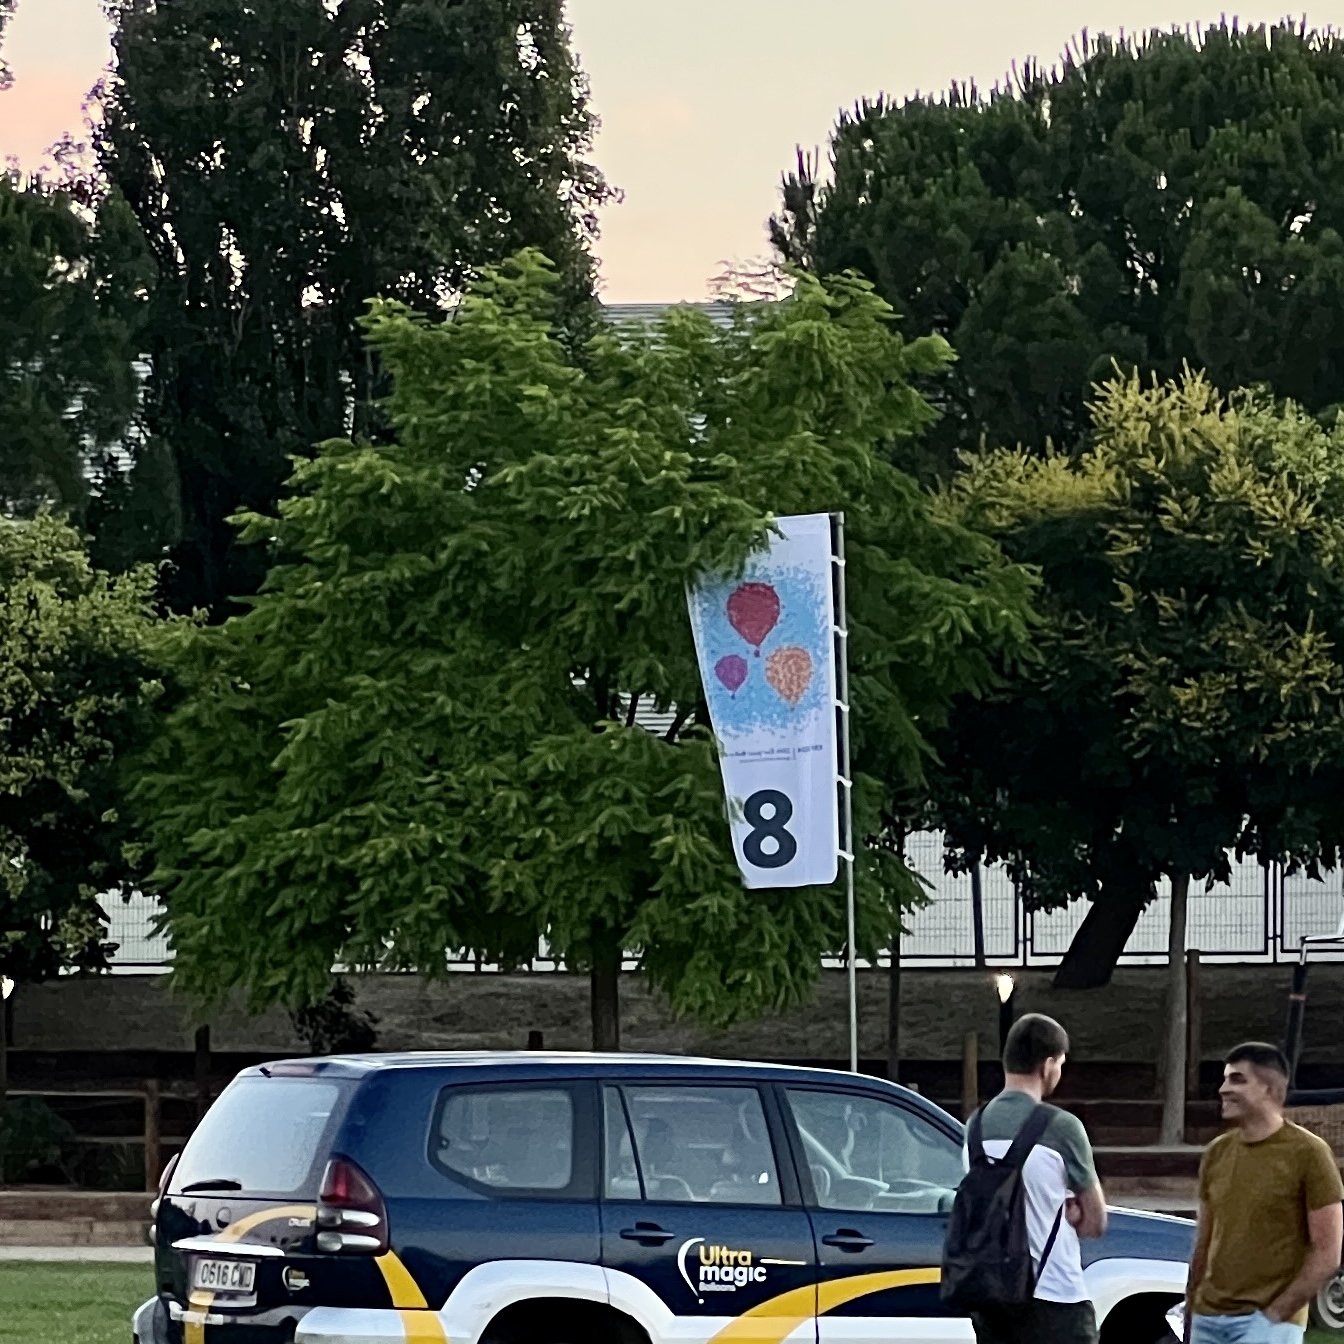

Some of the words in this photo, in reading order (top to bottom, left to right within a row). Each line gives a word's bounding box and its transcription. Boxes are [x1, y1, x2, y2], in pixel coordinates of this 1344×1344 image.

[700, 1245, 752, 1266] Ultra
[201, 1263, 228, 1287] 0616
[700, 1266, 767, 1287] magic
